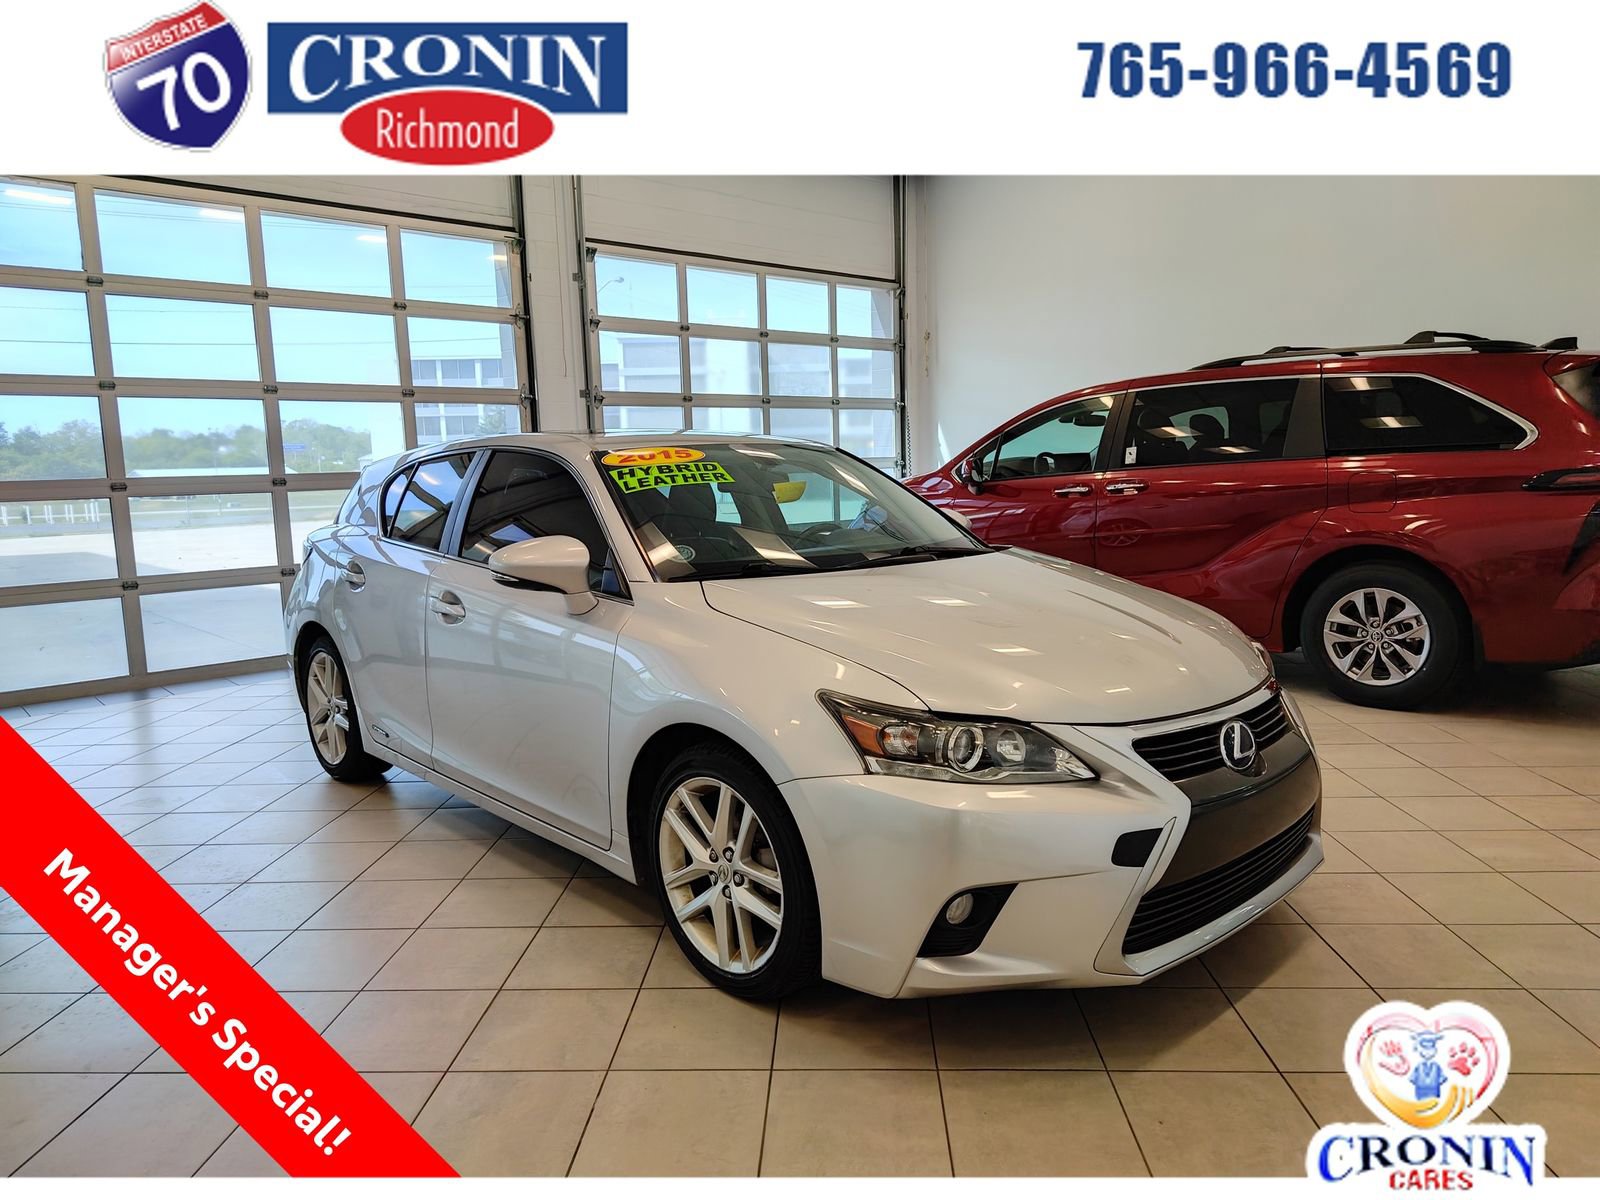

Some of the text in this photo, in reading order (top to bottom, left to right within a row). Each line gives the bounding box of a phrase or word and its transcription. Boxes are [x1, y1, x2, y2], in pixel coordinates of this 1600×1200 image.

[618, 449, 692, 464] 2015
[617, 463, 718, 480] HYBRID
[623, 472, 728, 491] LEATHER
